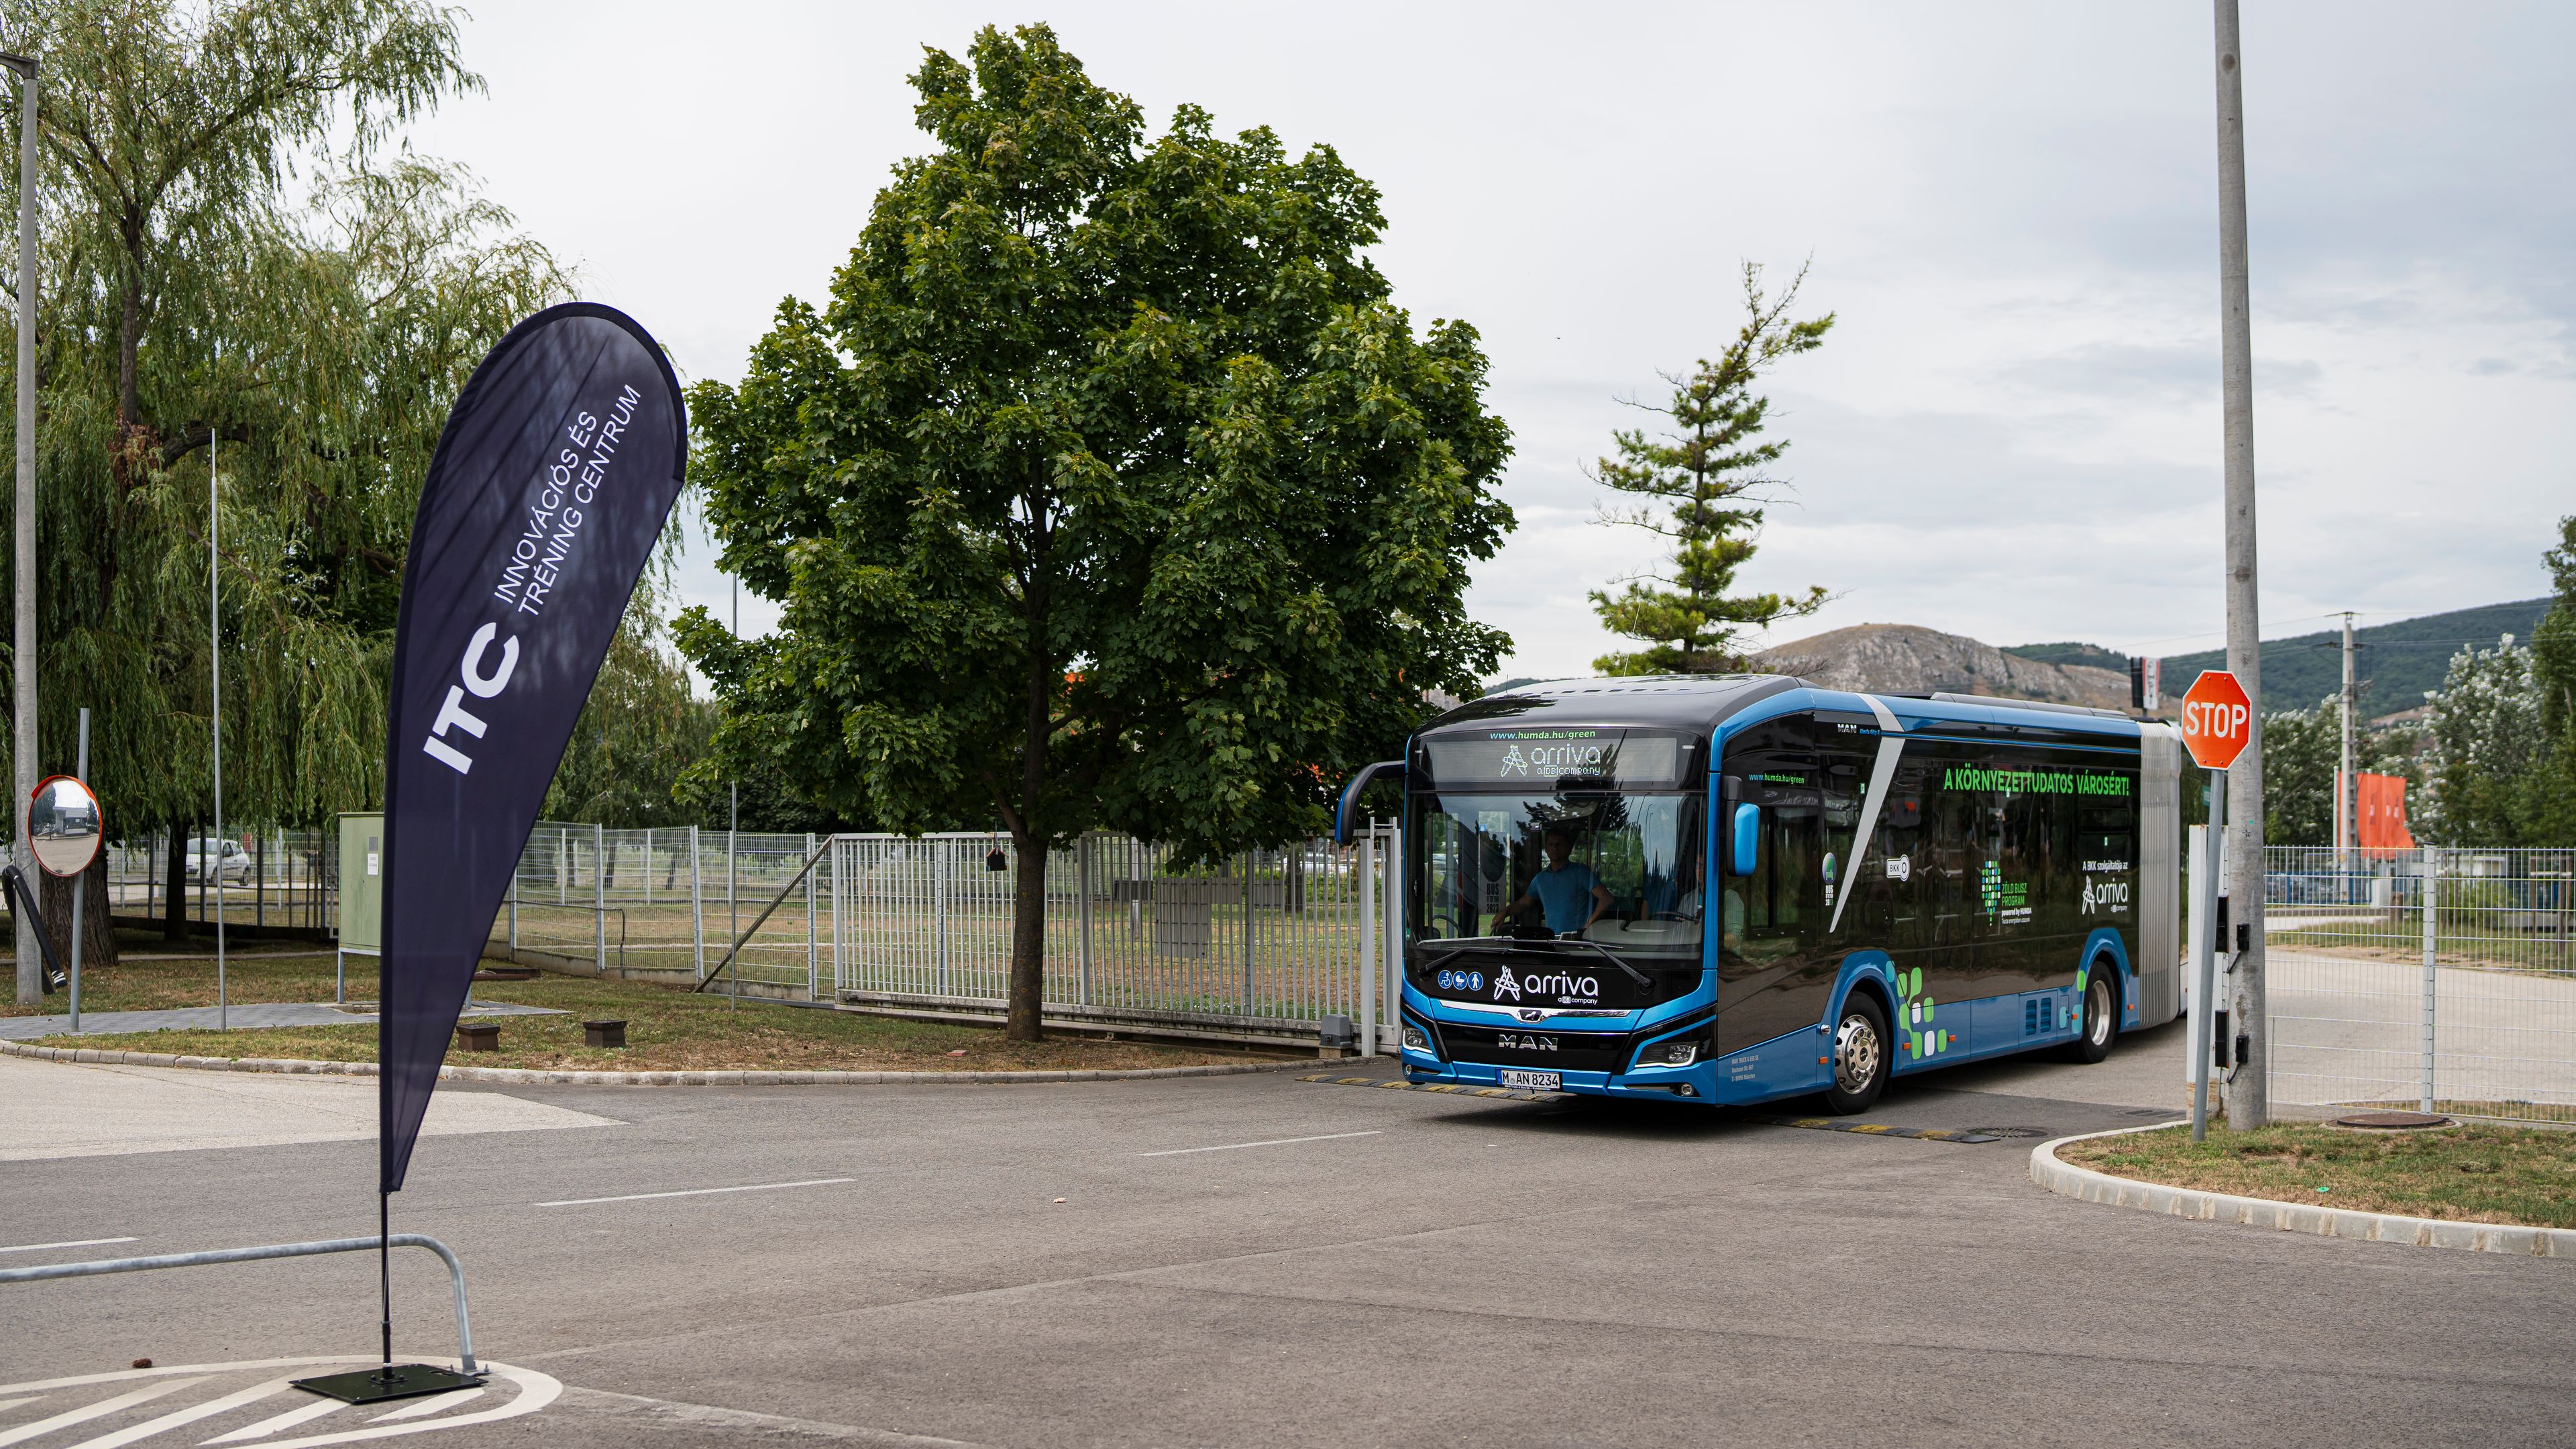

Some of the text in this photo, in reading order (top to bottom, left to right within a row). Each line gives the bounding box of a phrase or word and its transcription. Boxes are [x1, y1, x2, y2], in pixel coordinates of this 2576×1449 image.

[518, 384, 641, 616] TRÉNING CENTRUM
[494, 411, 598, 604] INNOVÁCIÓS ÉS
[423, 622, 520, 775] ITC
[2185, 701, 2247, 739] STOP
[1837, 723, 1857, 733] MAN
[1490, 730, 1596, 740] www.humda.hu/green
[1531, 743, 1601, 765] arriva
[1546, 767, 1556, 775] DB
[1558, 767, 1601, 776] company
[1749, 773, 1805, 785] www.humda.hu/green
[1944, 763, 2130, 796] A KÖRNYEZETTUDATOS VÁROSÉRT!
[1890, 864, 1900, 872] BKK
[2082, 861, 2087, 871] A
[2087, 861, 2096, 871] BKK
[2123, 861, 2129, 870] az
[1487, 883, 1499, 895] BUS
[2015, 883, 2027, 894] BUSZ
[2096, 877, 2128, 904] arriva
[2001, 895, 2025, 906] PROGRAM
[1487, 903, 1499, 913] 2023
[2016, 908, 2021, 917] by
[1524, 971, 1599, 997] arriva
[1571, 998, 1598, 1006] company
[1498, 1034, 1558, 1051] MAN
[1502, 1071, 1558, 1087] M AN 8234
